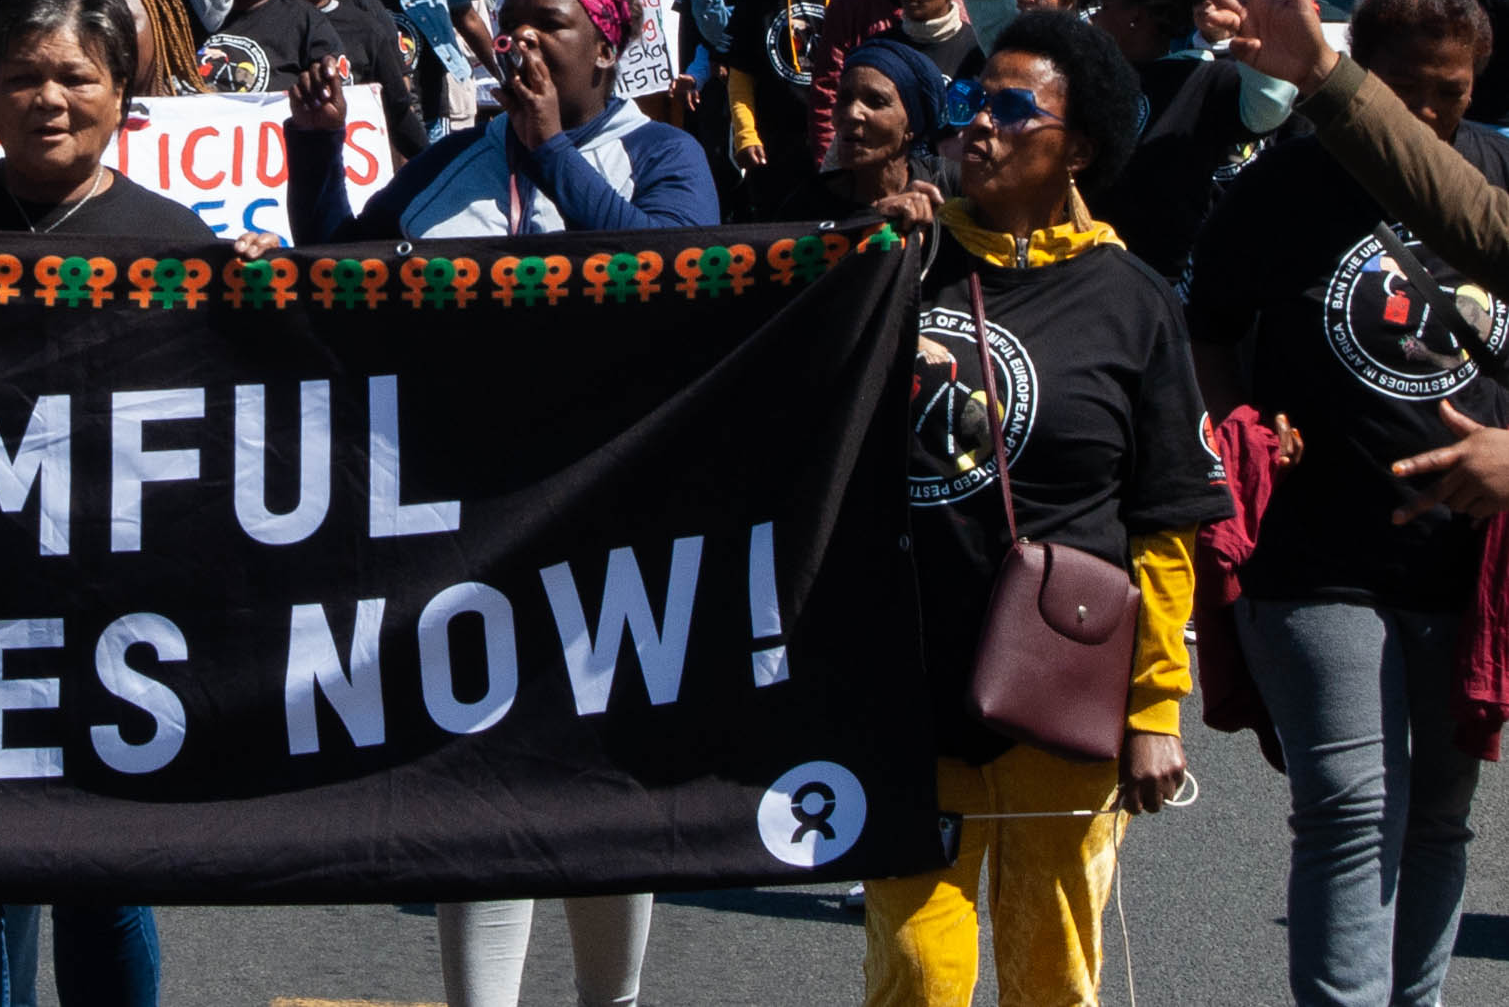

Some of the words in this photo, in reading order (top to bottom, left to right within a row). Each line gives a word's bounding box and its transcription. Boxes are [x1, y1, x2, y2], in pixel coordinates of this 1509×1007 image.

[118, 120, 380, 191] TICIDS
[1332, 282, 1349, 310] BAN
[1341, 255, 1363, 280] THE
[936, 315, 958, 328] OF
[1333, 322, 1365, 368] AFRICA
[1362, 369, 1378, 380] IN
[1379, 372, 1456, 393] PESTICIDES
[285, 521, 790, 756] NOW!
